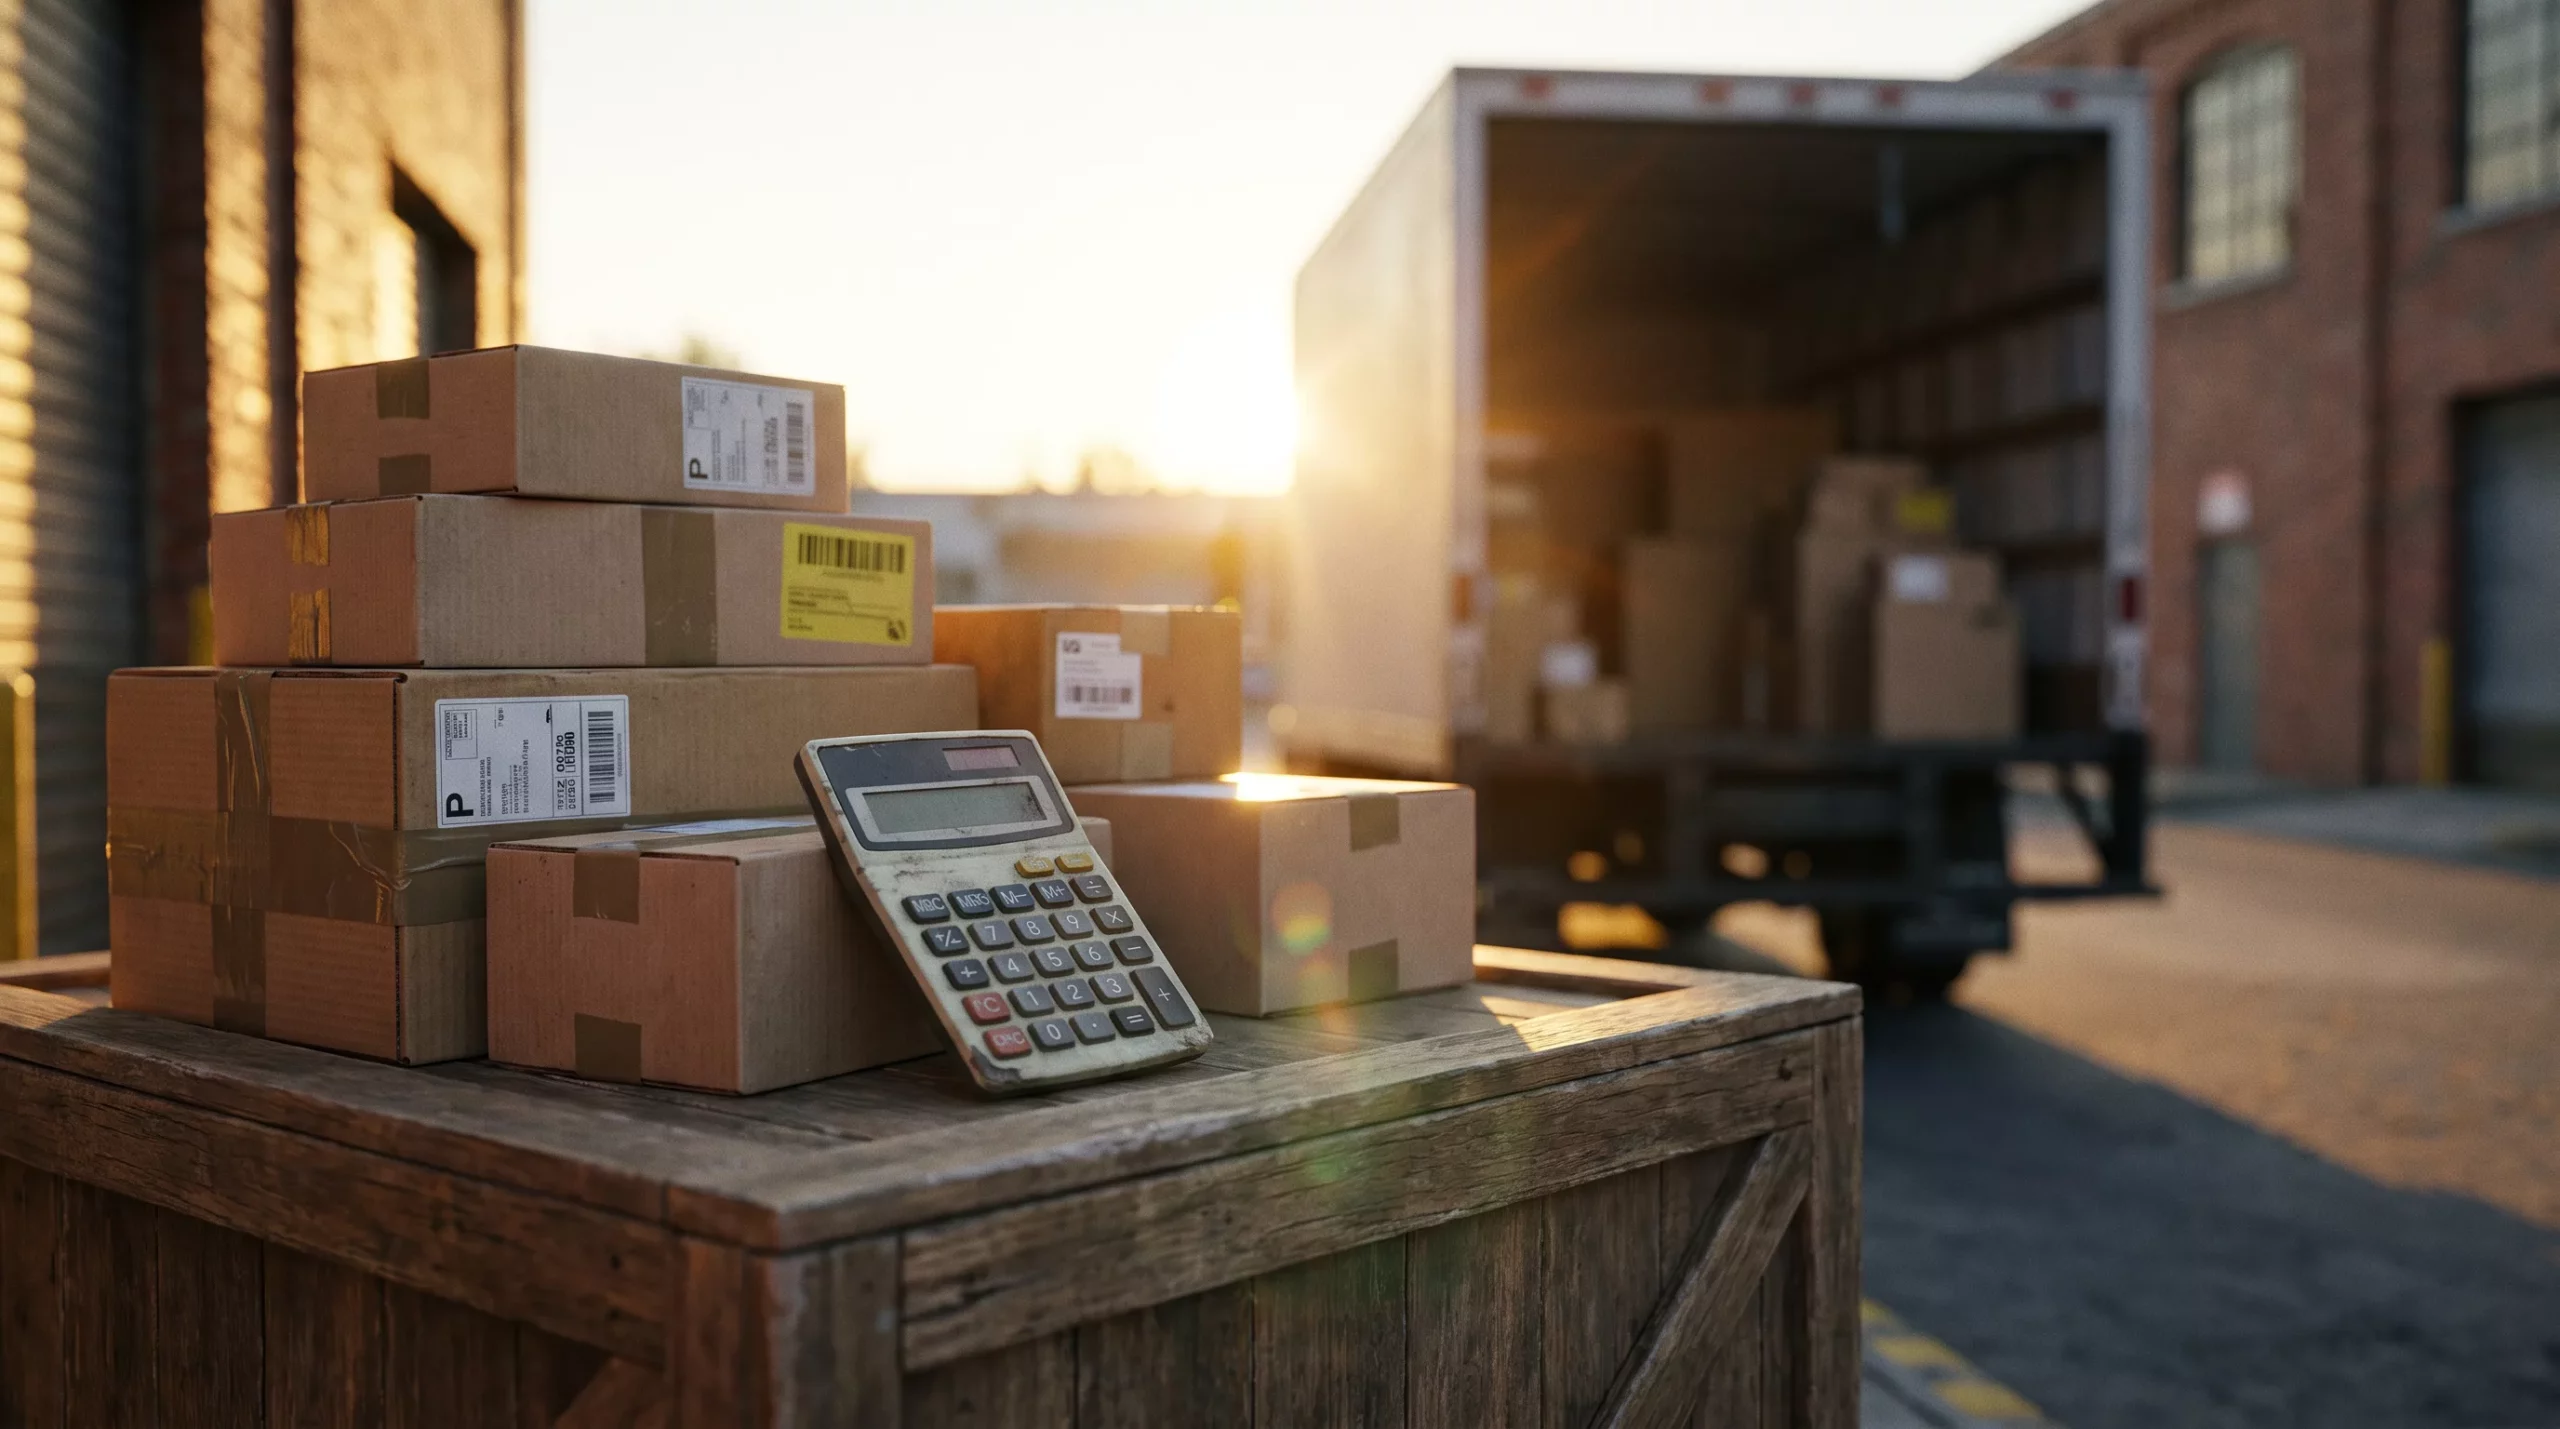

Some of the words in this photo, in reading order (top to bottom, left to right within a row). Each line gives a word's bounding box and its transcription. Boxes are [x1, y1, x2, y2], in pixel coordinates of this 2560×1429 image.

[689, 457, 708, 480] P
[446, 792, 474, 818] P
[1041, 885, 1065, 899] M+
[1026, 920, 1041, 936] 8
[1066, 914, 1079, 929] 9
[984, 925, 997, 941] 7
[1046, 951, 1063, 967] 5
[1088, 946, 1101, 961] 6
[1007, 957, 1020, 973] 4
[1067, 984, 1083, 1000] 2
[1106, 978, 1122, 994] 3
[1026, 990, 1039, 1006] 1
[1158, 987, 1171, 1002] +
[1046, 1023, 1062, 1040] 0
